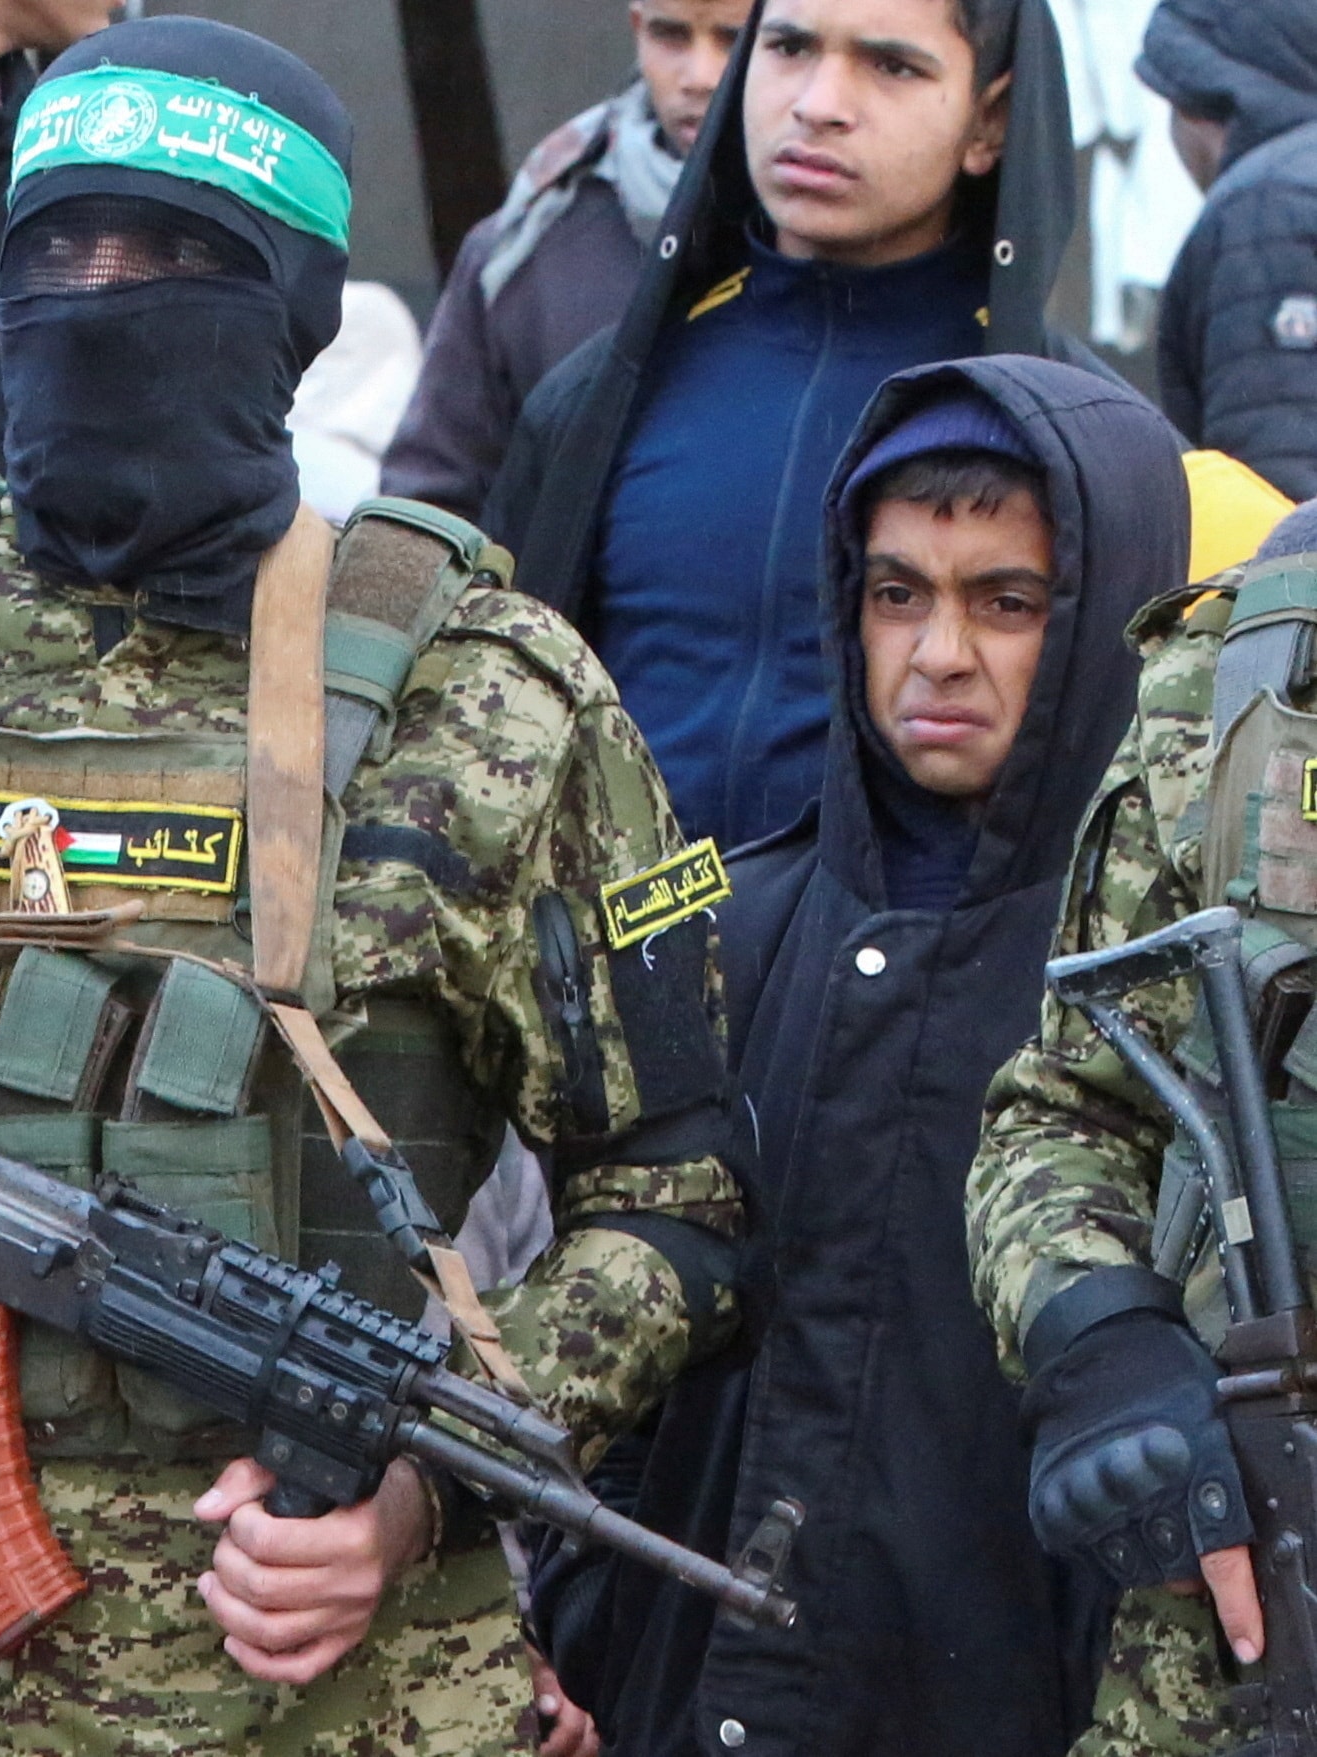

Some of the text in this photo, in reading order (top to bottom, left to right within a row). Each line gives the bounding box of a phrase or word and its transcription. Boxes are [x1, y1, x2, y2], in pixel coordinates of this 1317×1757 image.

[165, 94, 213, 119] الله
[126, 827, 224, 869] كتائب
[614, 877, 675, 936] القسام
